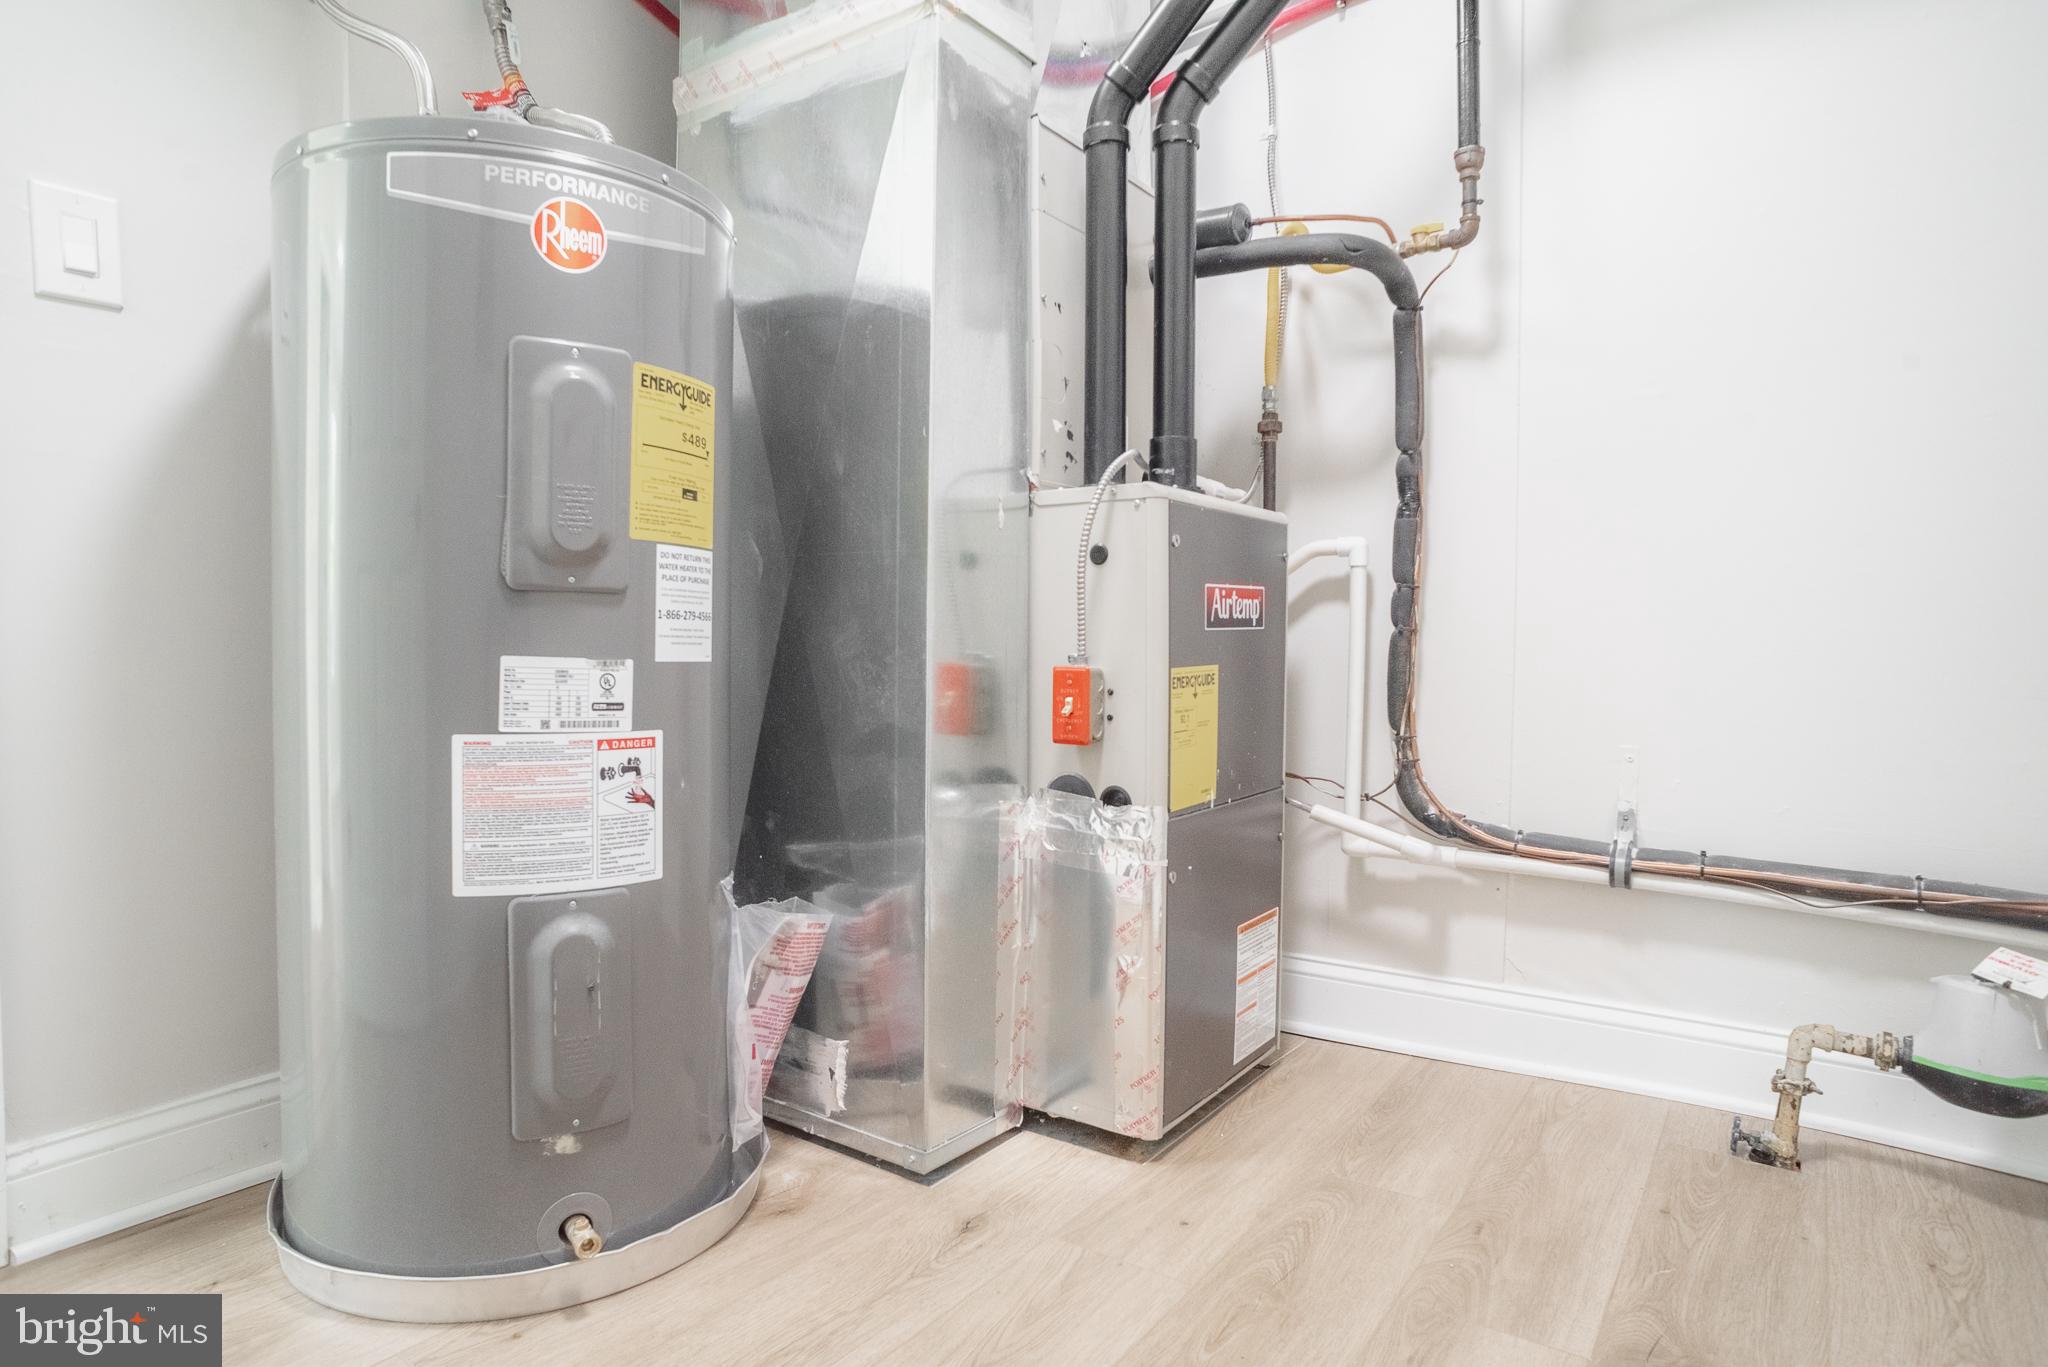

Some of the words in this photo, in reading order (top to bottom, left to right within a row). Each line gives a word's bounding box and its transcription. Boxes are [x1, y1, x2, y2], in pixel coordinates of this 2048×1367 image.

[484, 164, 650, 213] PERFORMANCE
[541, 200, 603, 260] Rheem
[641, 373, 711, 408] ENERGYGUIDE
[682, 432, 707, 450] $489
[660, 551, 670, 559] DO
[671, 552, 682, 560] NOT
[659, 562, 678, 571] WATER
[679, 564, 697, 573] HEATER
[661, 574, 679, 582] PLACE
[1211, 588, 1260, 627] Airtemp
[1172, 673, 1215, 690] ENERGYGUIDE
[612, 738, 653, 750] DANGER
